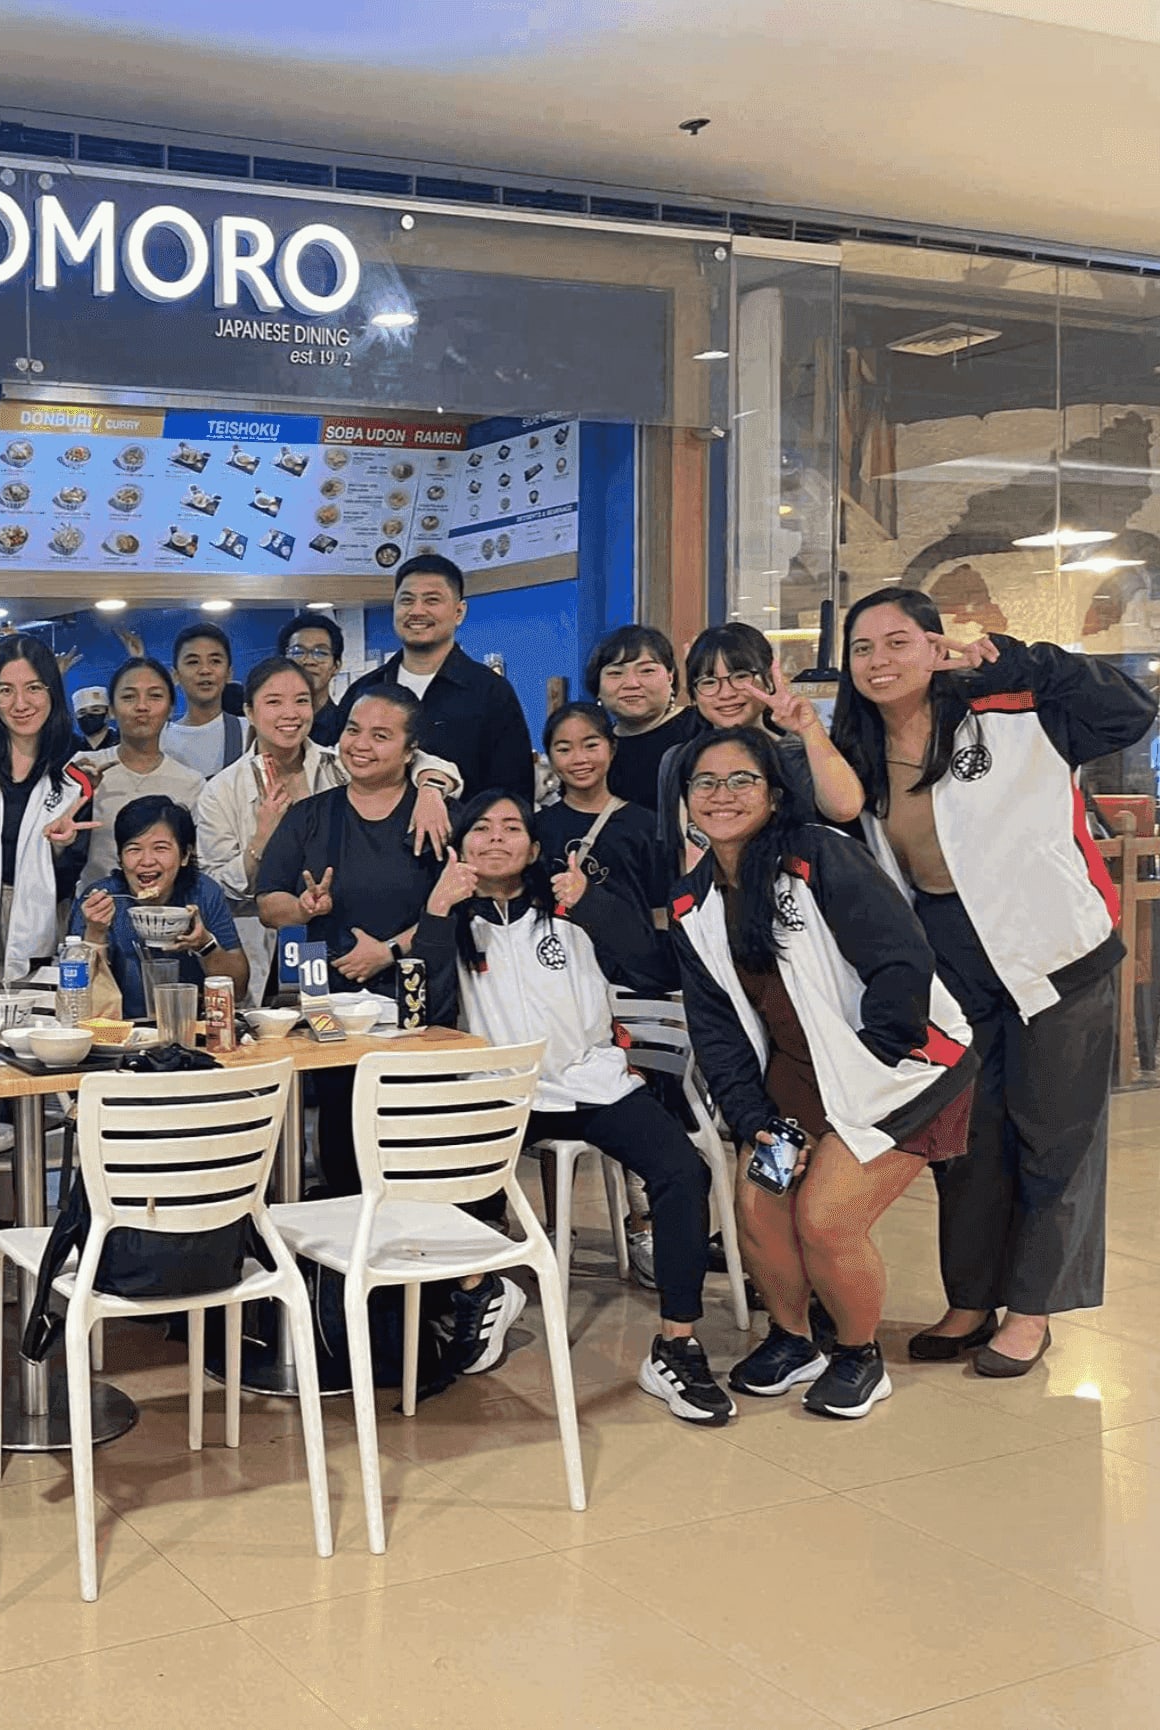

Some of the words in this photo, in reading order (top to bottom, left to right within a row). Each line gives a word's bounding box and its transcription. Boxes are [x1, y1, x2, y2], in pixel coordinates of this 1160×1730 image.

[215, 318, 290, 342] JAPANESE
[294, 325, 350, 347] DINING
[289, 350, 317, 364] est.
[319, 350, 352, 366] 192
[20, 411, 92, 428] DONBURI
[105, 419, 141, 430] CURRY
[207, 420, 281, 437] TEISHOKU
[325, 425, 364, 440] SOBA
[366, 428, 406, 442] UDON
[414, 431, 462, 445] RAMEN
[284, 942, 300, 967] 9
[299, 959, 328, 986] 10
